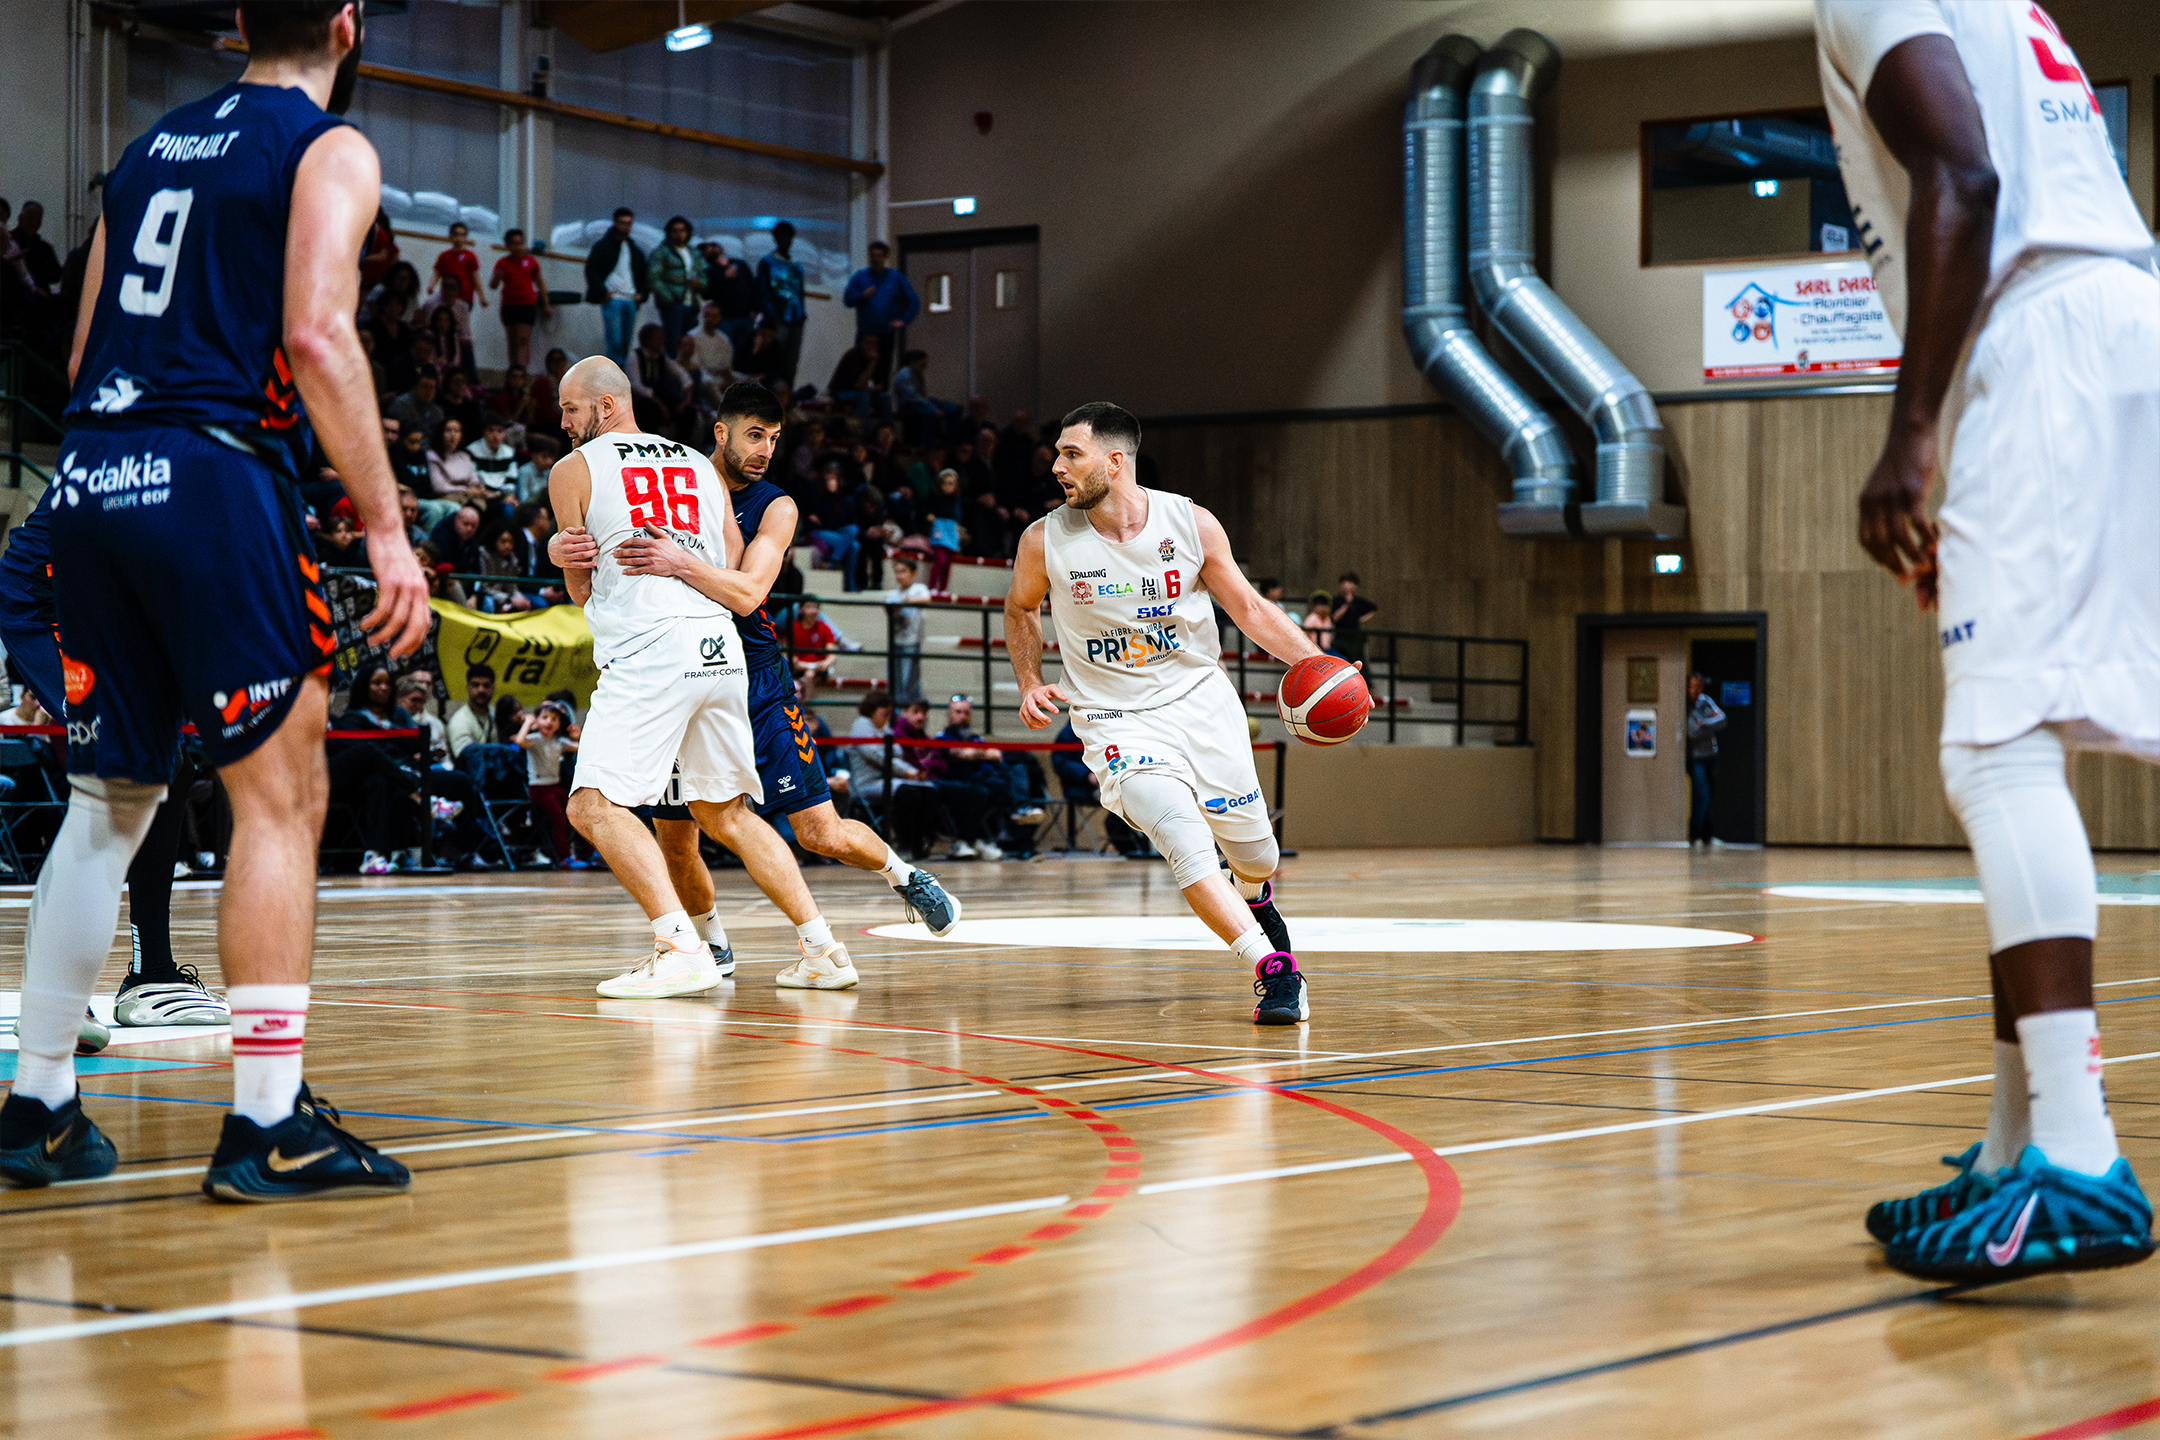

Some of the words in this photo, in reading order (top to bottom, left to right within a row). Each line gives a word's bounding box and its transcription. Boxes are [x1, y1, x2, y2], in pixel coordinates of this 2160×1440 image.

[148, 130, 241, 162] PINGAULT
[119, 186, 195, 318] 9
[1795, 279, 1832, 295] SARL
[613, 443, 688, 461] PMM
[87, 451, 171, 495] dalkia
[621, 467, 700, 535] 96
[1069, 568, 1107, 580] SPALDING
[1164, 569, 1181, 599] 6
[1097, 582, 1134, 596] ECLA
[1141, 586, 1157, 597] ra
[1100, 630, 1110, 638] LA
[1110, 627, 1132, 637] FIBRE
[1145, 621, 1163, 634] JURA
[1086, 624, 1180, 663] PRISME
[502, 656, 547, 685] ra
[1086, 709, 1123, 722] SPALDING
